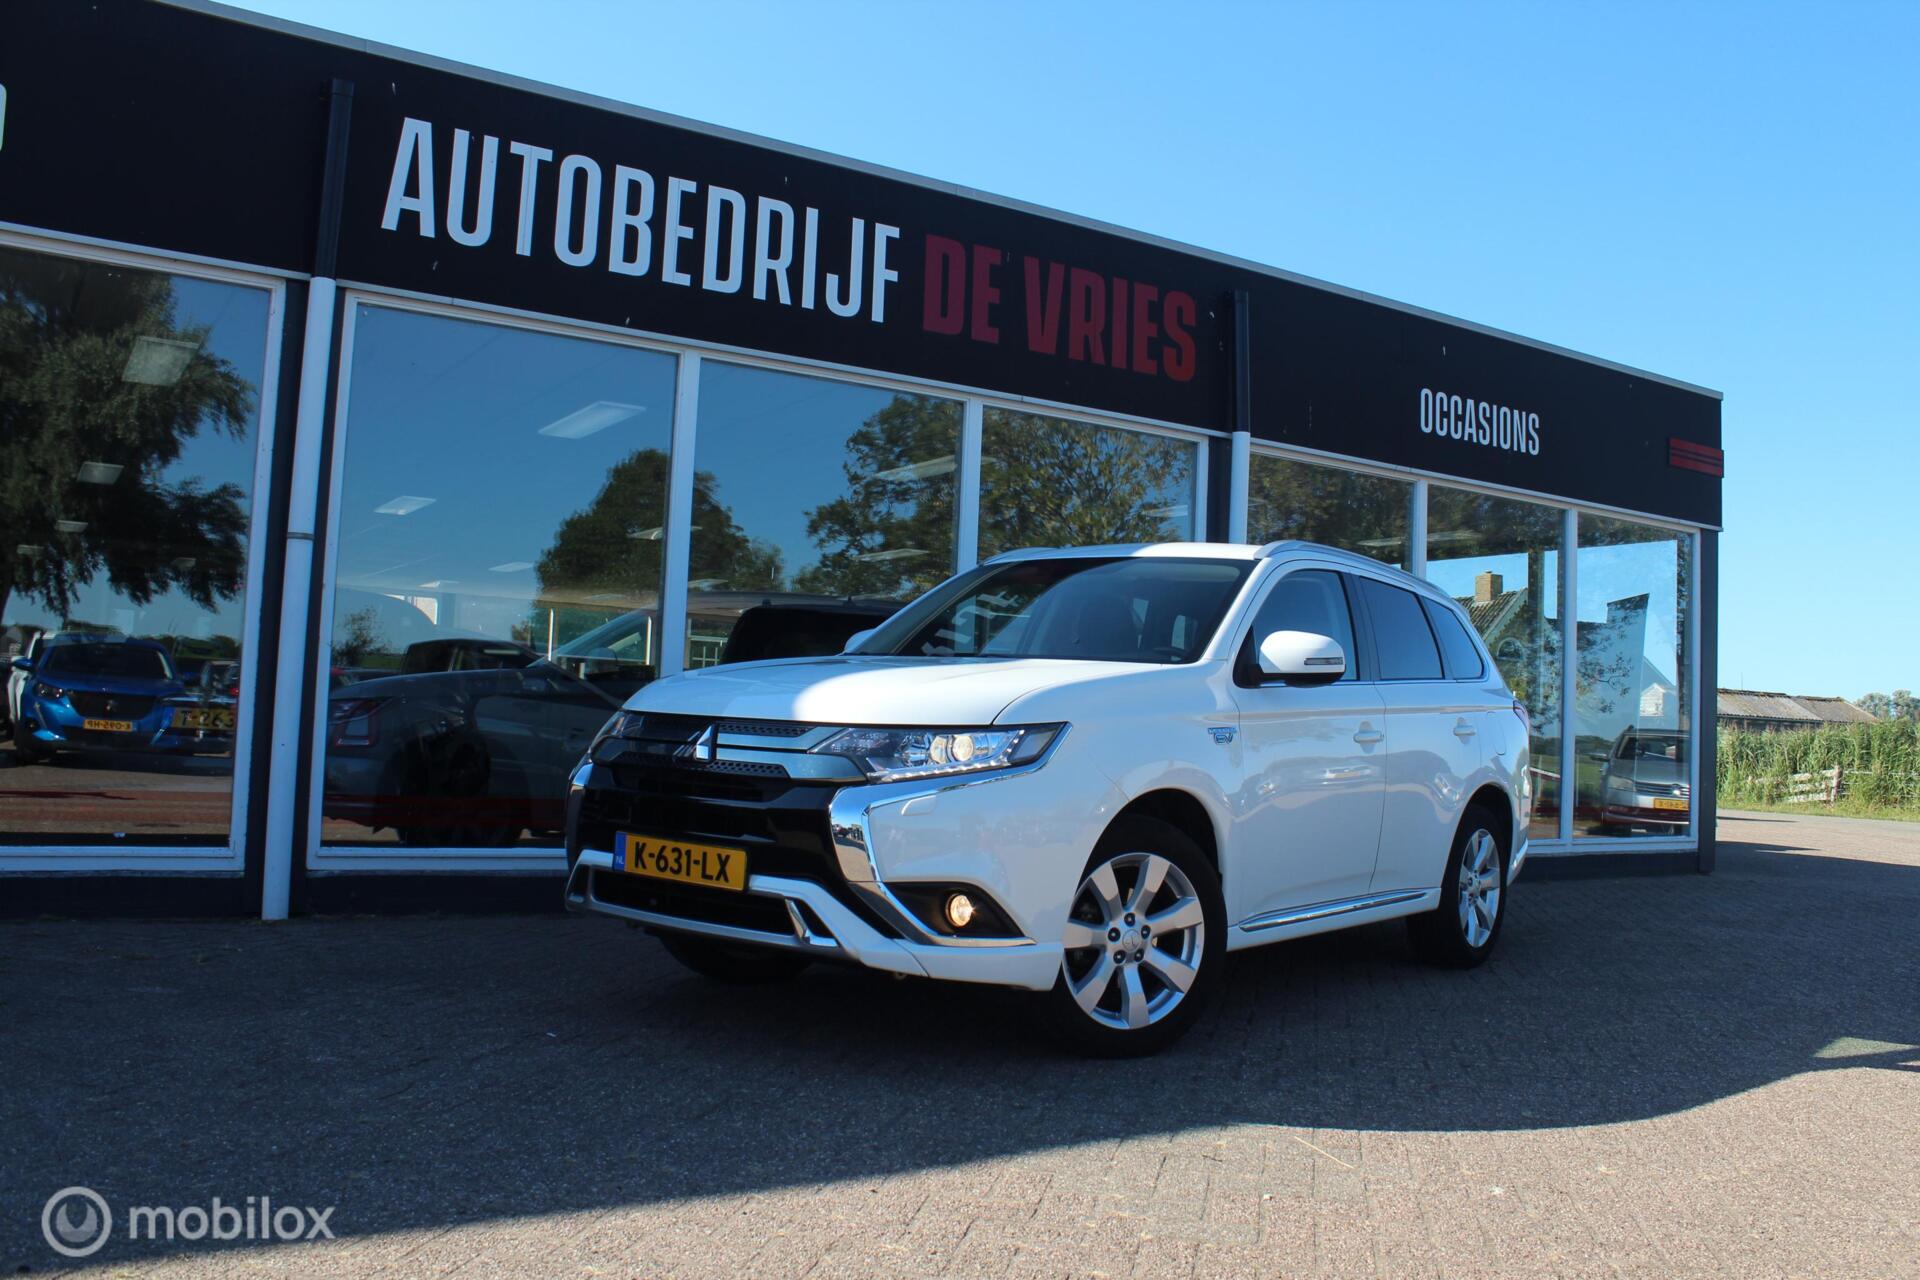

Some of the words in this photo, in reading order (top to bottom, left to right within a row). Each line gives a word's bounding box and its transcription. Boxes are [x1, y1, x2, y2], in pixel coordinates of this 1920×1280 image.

[381, 117, 901, 323] AUTOBEDRIJF
[922, 233, 1002, 344] DE
[1024, 255, 1197, 382] VRIES
[1420, 387, 1540, 456] OCCASIONS
[634, 841, 731, 883] K-631-LX
